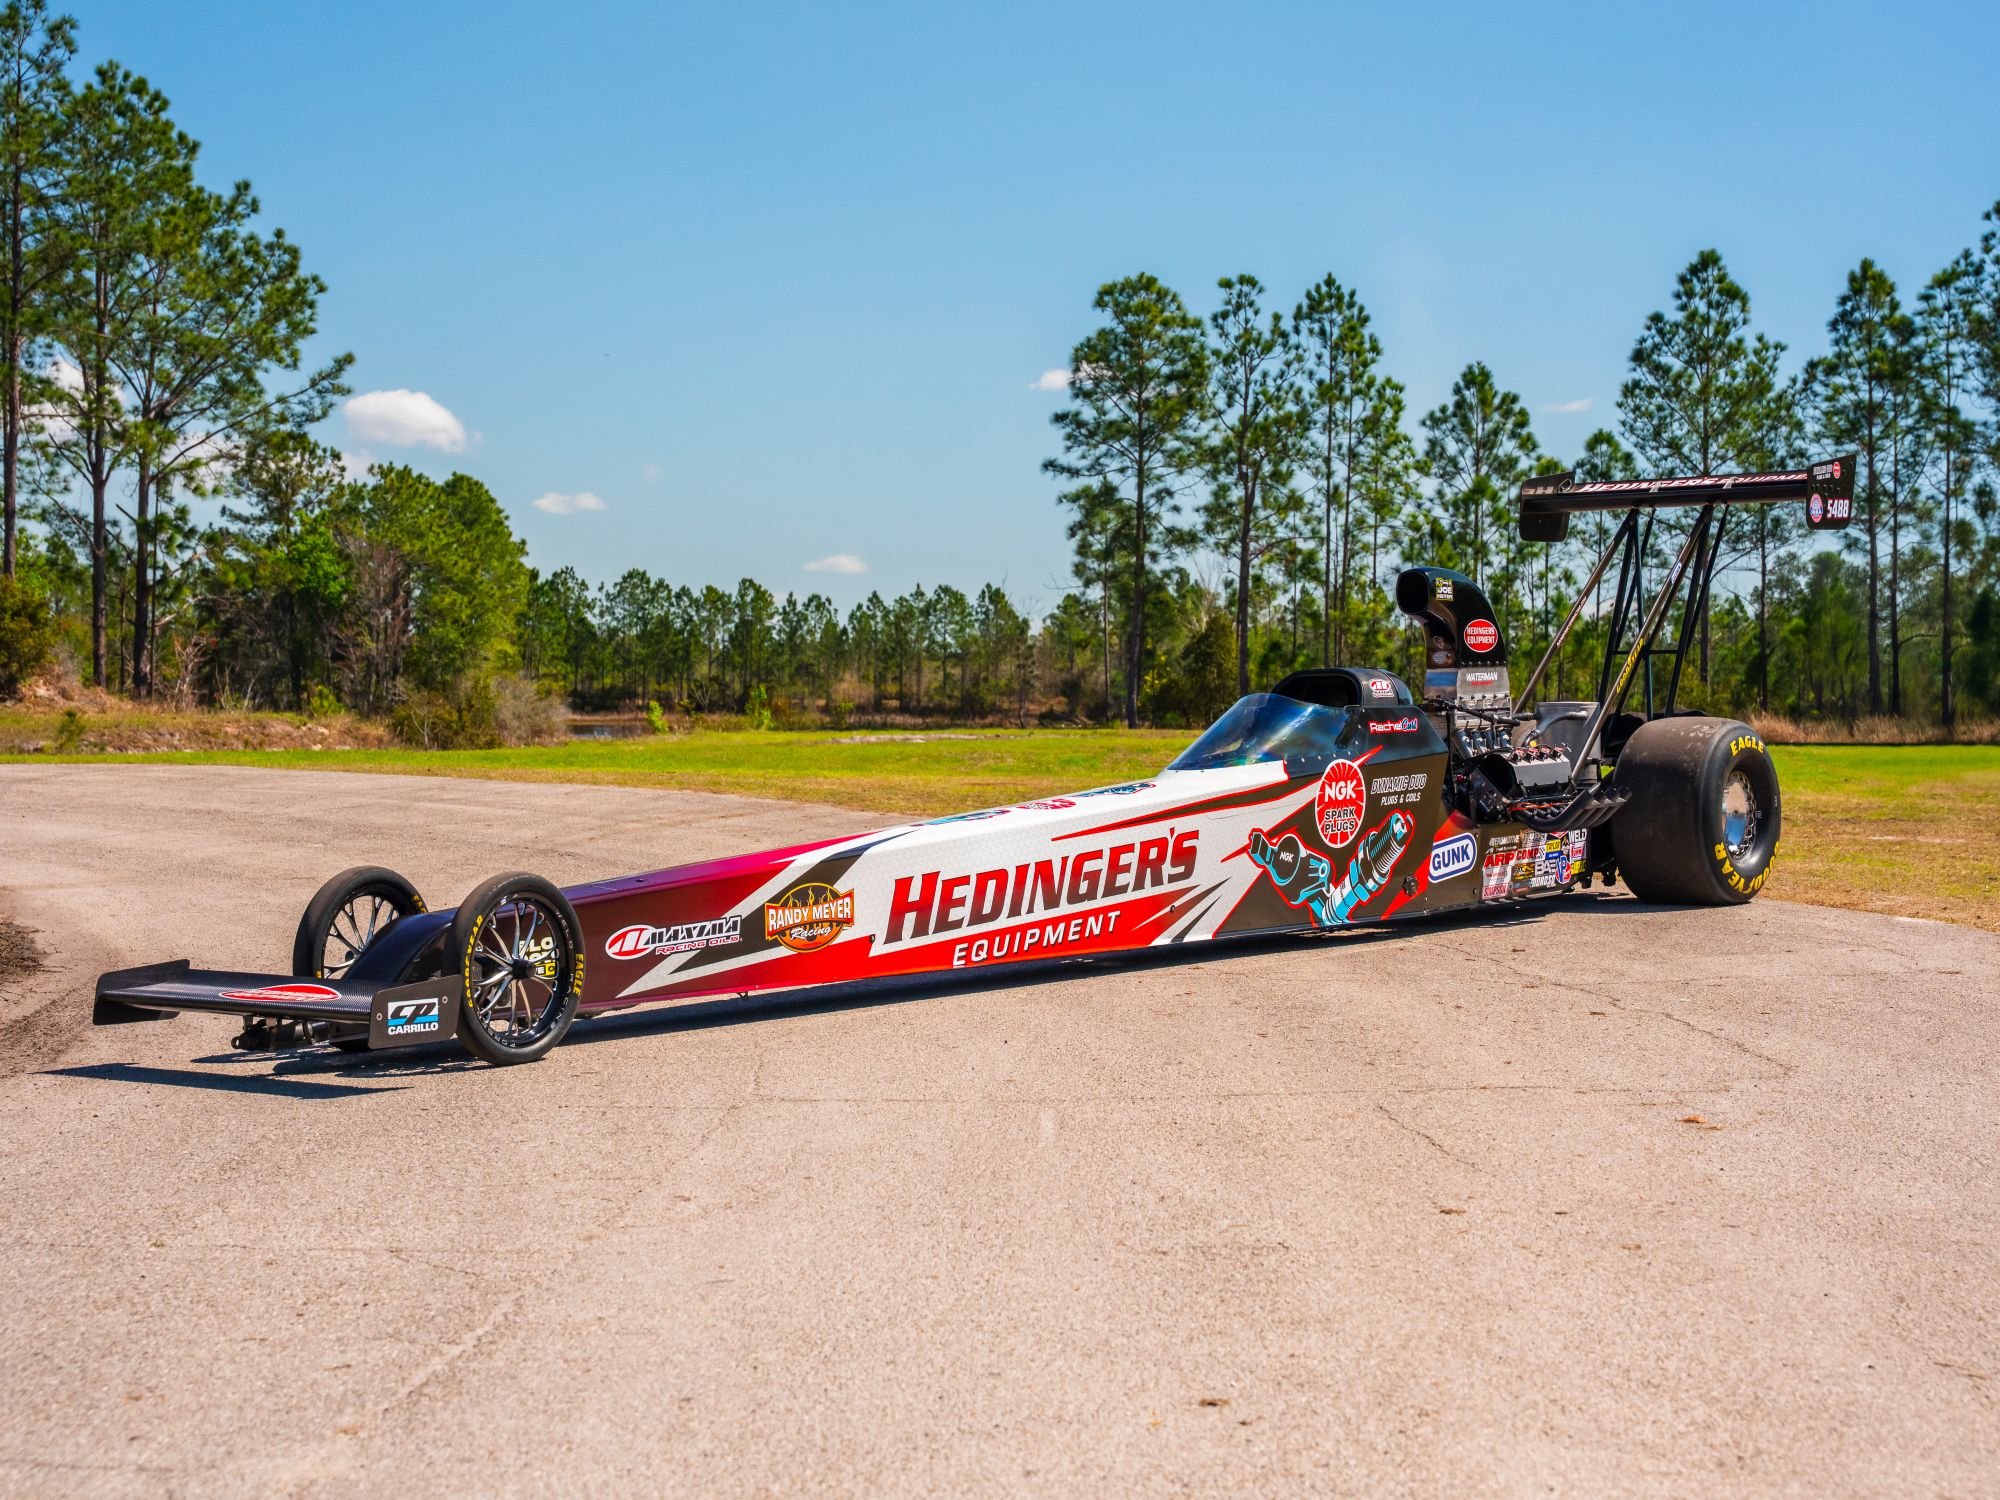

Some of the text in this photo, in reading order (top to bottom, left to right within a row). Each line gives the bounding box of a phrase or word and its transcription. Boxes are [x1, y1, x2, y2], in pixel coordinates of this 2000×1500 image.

[1827, 498, 1850, 518] 5488
[1437, 586, 1453, 594] JOE
[1467, 635, 1495, 644] EQUIPMENT
[1466, 671, 1498, 682] WATERMAN
[1729, 735, 1764, 757] EAGLE
[1324, 779, 1357, 802] NGK
[1371, 773, 1427, 794] DYNAMIC DUO
[1381, 795, 1398, 806] PLUGS
[1406, 792, 1421, 802] COILS
[1324, 806, 1356, 820] SPARK
[1324, 820, 1355, 834] PLUGS
[1568, 829, 1587, 844] WELD
[1279, 851, 1294, 863] NGK
[1432, 843, 1471, 871] GUNK
[1484, 852, 1515, 868] ARP
[1516, 848, 1539, 861] COMP
[1535, 859, 1556, 876] BAE
[882, 827, 1199, 945] HEDINGER'S
[768, 897, 851, 932] RANDY MEYER
[643, 916, 740, 946] MAXIMA
[790, 926, 832, 940] Racing
[952, 910, 1121, 967] EQUIPMENT
[656, 935, 740, 955] RACING OILS
[464, 914, 484, 1008] GOODYEAR
[573, 953, 585, 997] EAGLE
[387, 1022, 439, 1036] CARRILLO
